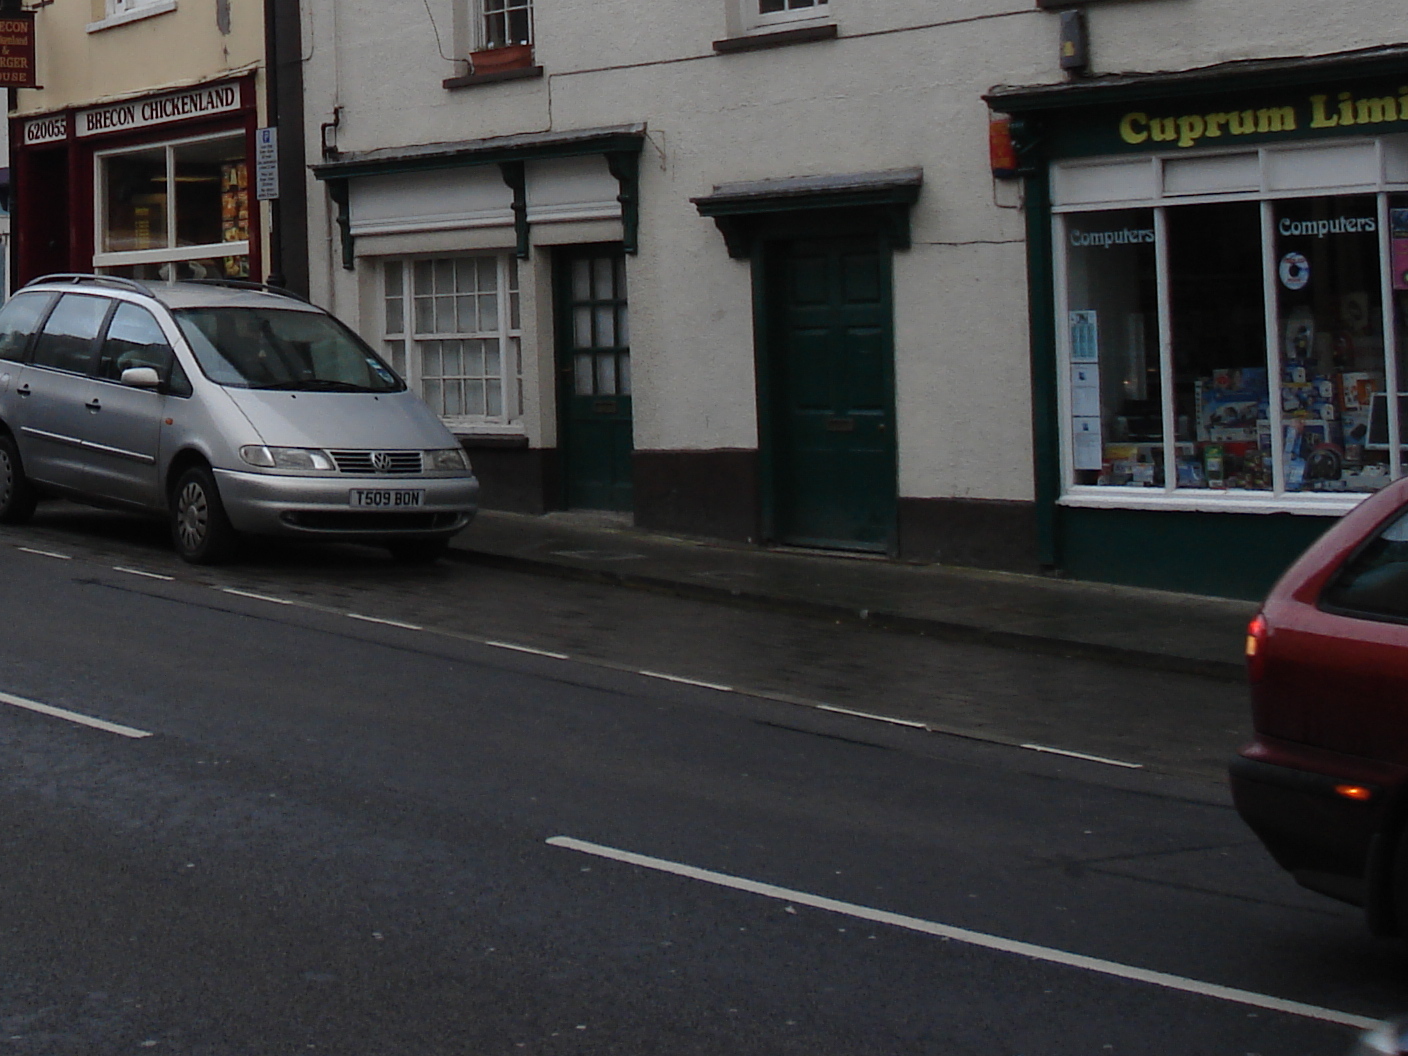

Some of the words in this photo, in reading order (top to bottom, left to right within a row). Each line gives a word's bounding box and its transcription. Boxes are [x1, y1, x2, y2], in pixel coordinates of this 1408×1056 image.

[2, 45, 10, 55] &
[86, 105, 136, 132] BRECON
[141, 86, 235, 122] CHICKENLAND
[1119, 105, 1297, 148] Cuprum
[1309, 85, 1408, 129] Limi
[27, 118, 67, 141] 620055
[1070, 227, 1155, 248] Computers
[1279, 215, 1376, 238] Computers
[356, 491, 391, 506] T509
[394, 491, 420, 506] BON
